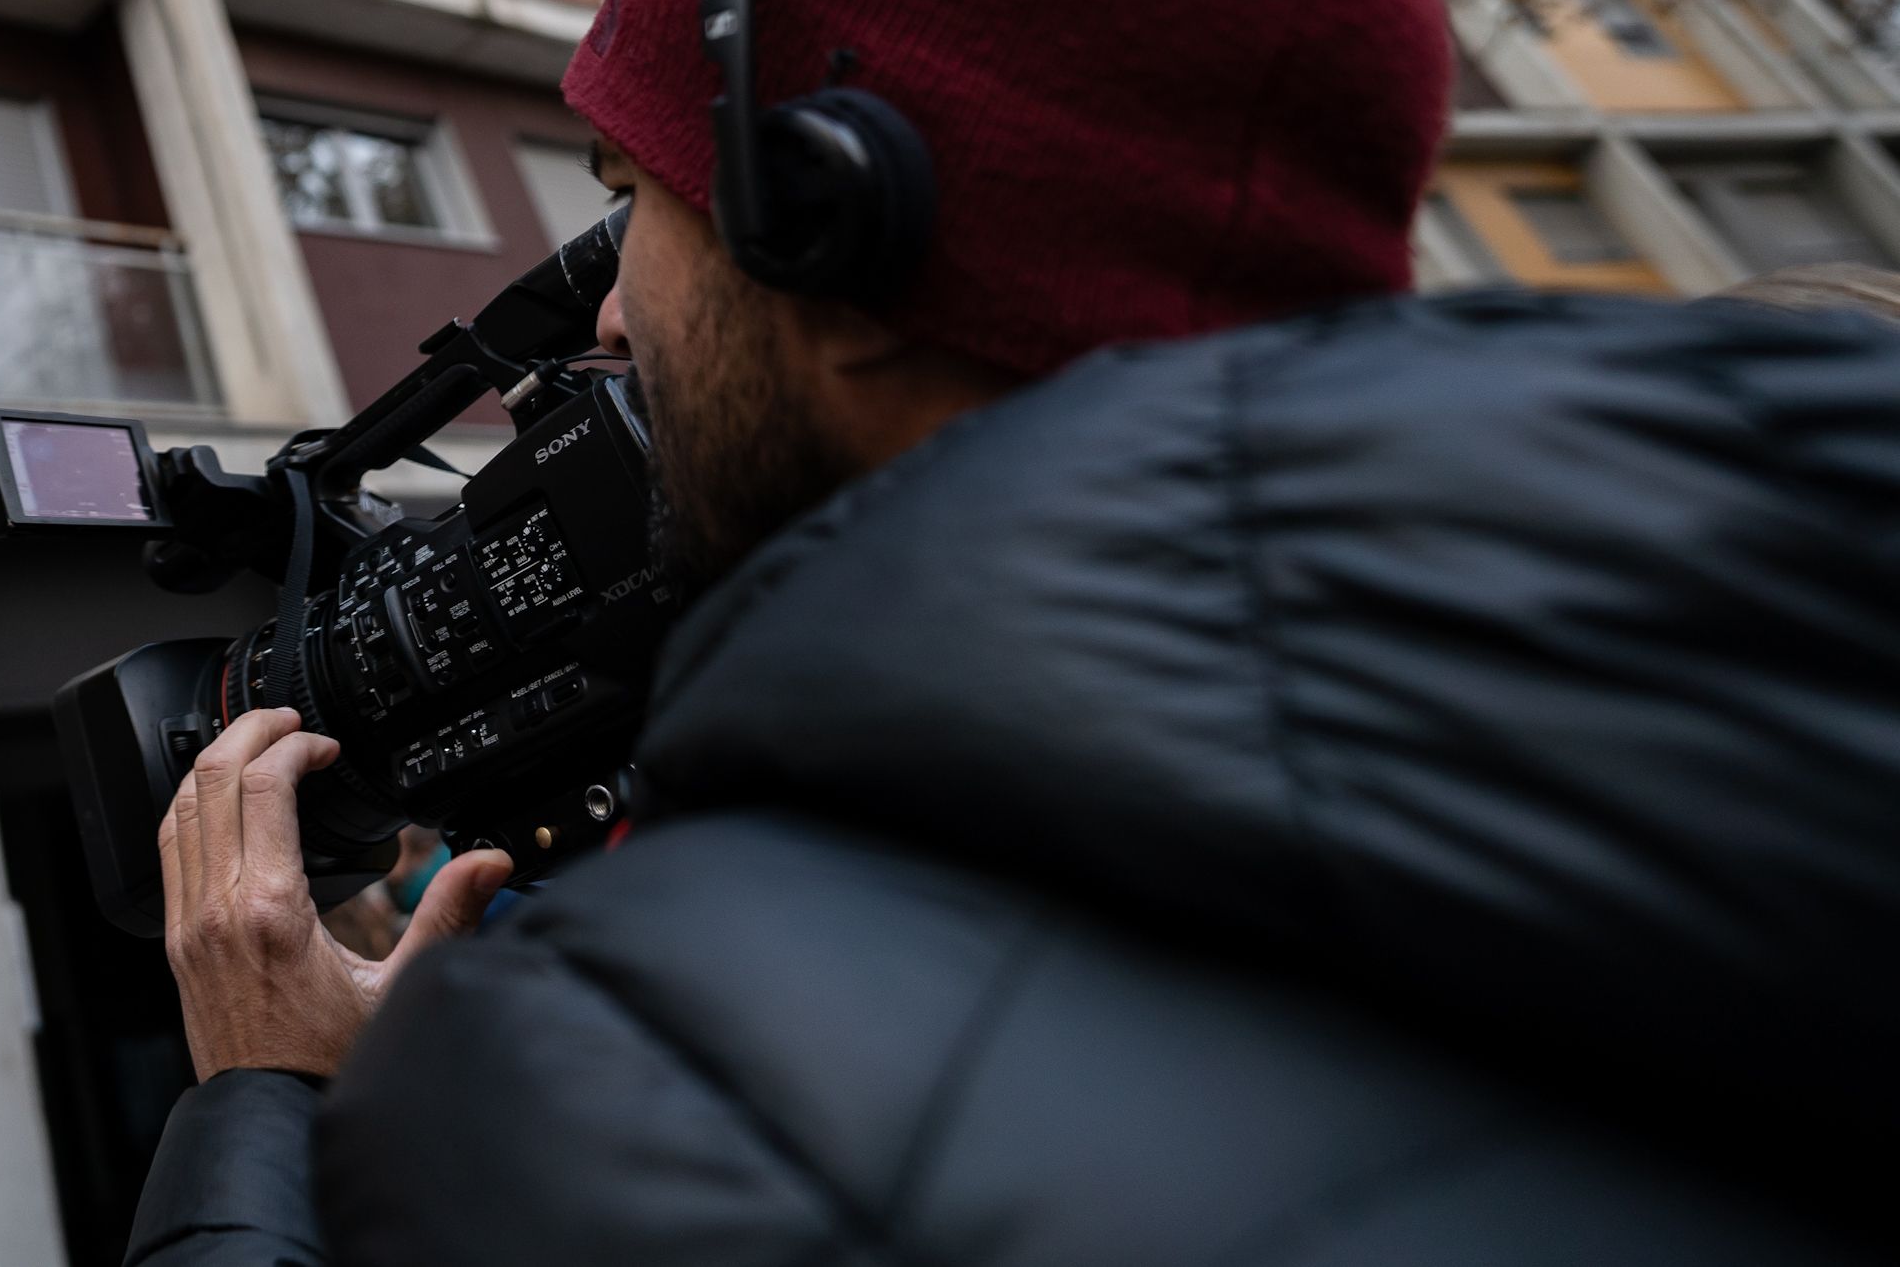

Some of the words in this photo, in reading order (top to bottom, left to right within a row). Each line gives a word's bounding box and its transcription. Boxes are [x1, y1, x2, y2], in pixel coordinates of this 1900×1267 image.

[534, 417, 591, 465] SONY
[548, 540, 563, 552] CH-1
[552, 549, 567, 561] CH-2
[401, 575, 421, 591] FOCUS
[552, 594, 568, 607] AUDIO
[565, 586, 585, 600] LEVEL
[449, 599, 469, 615] STATUS
[451, 606, 472, 620] CHECK
[468, 639, 489, 655] MENU
[426, 649, 450, 666] SHUTTER
[516, 678, 542, 698] SEL/SET
